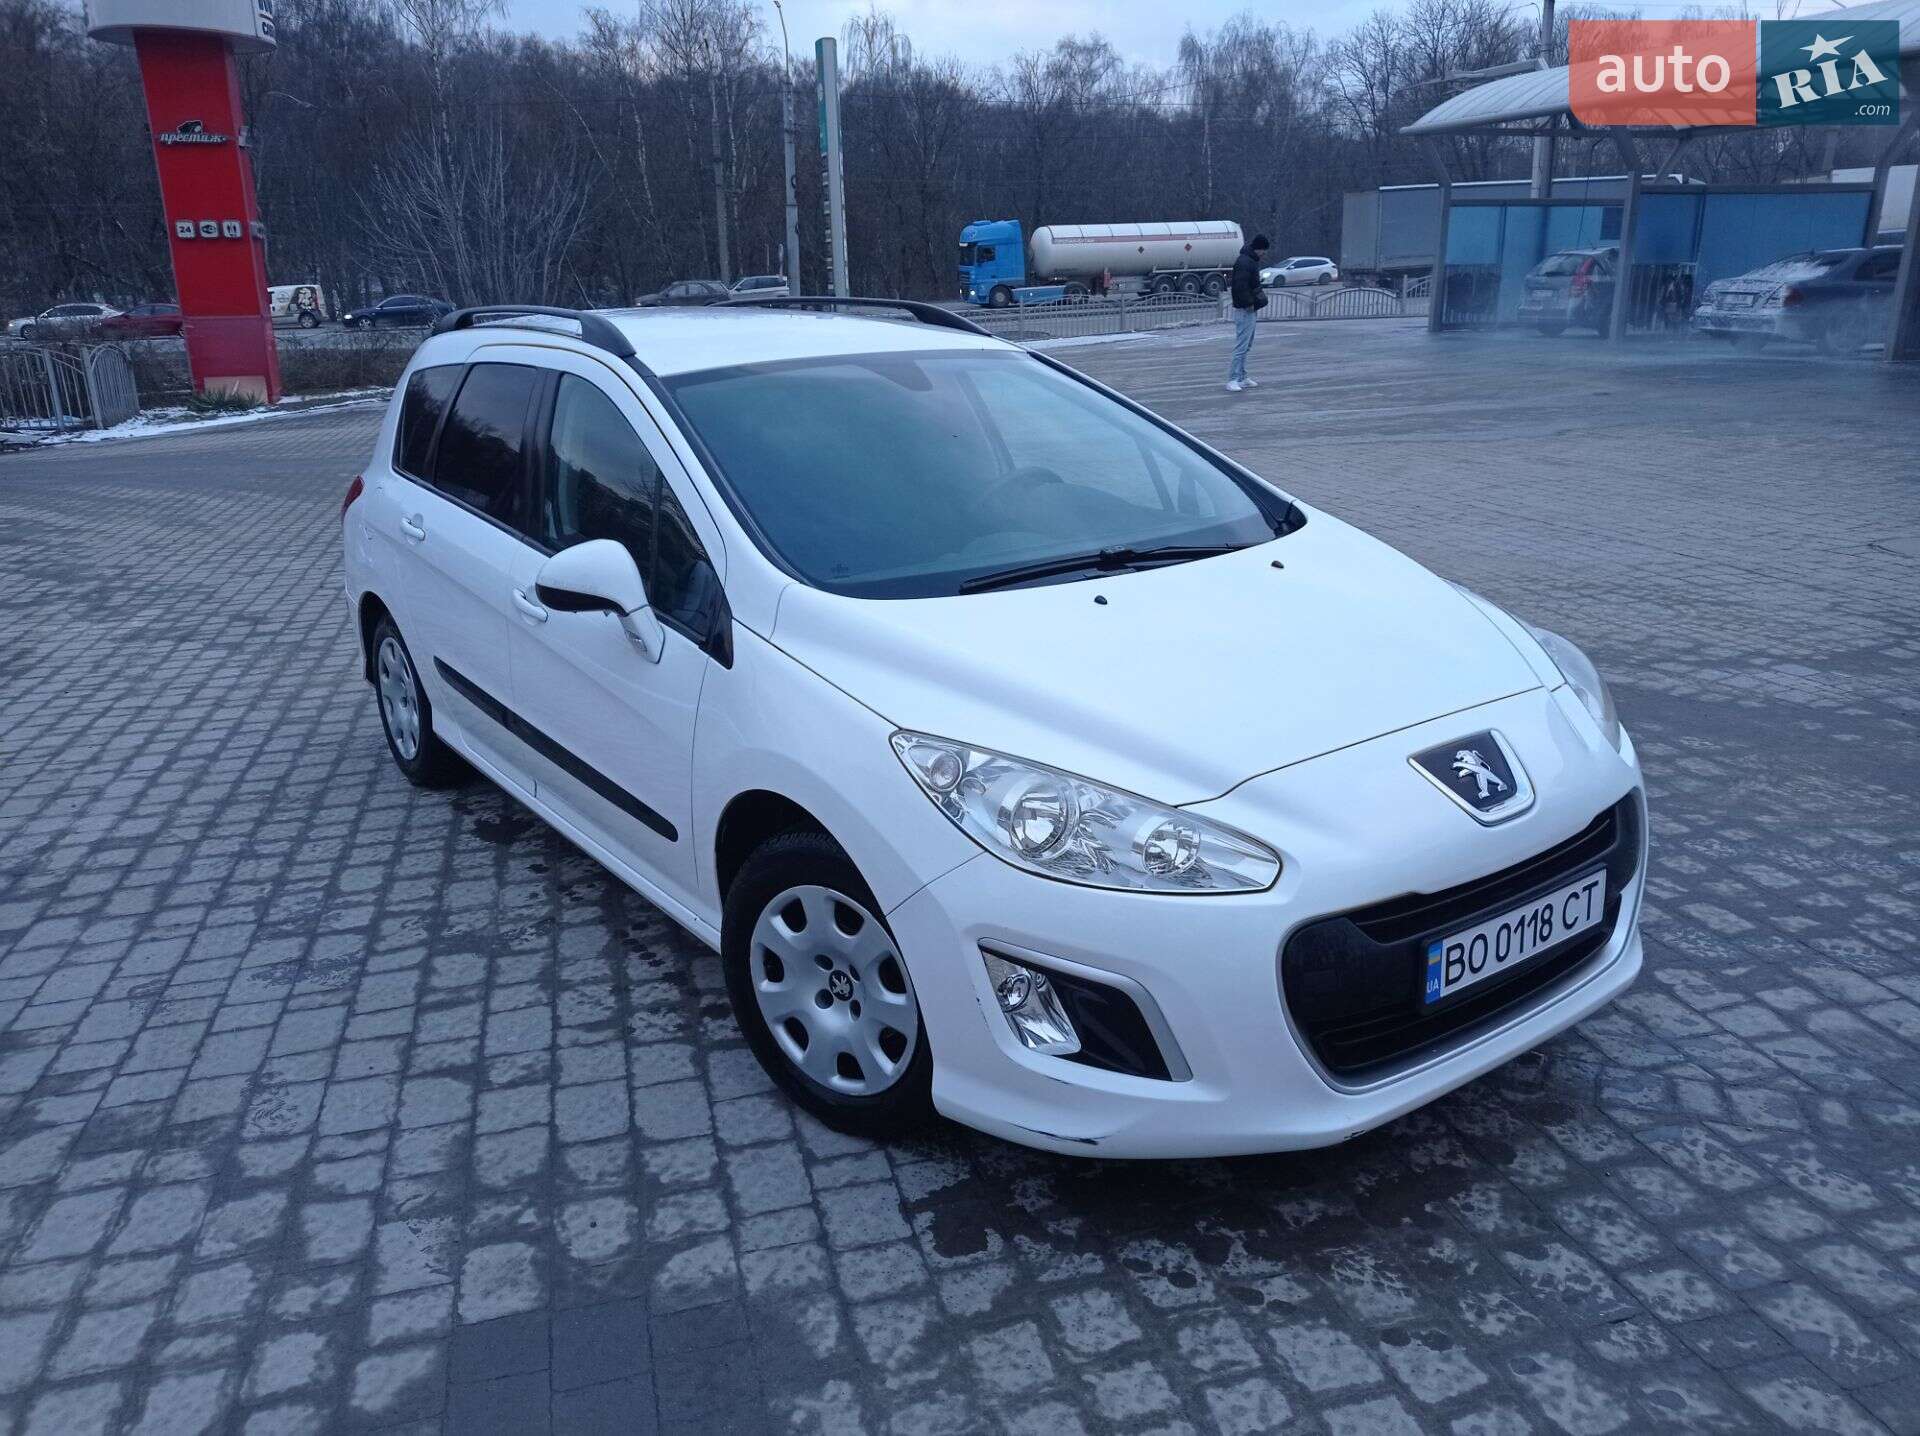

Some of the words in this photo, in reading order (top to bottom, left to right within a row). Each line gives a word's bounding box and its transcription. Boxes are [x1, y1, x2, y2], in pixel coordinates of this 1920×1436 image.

[178, 225, 192, 233] 24
[1445, 933, 1489, 987] BO
[1495, 903, 1554, 962] 0118
[1562, 880, 1599, 930] CT
[1426, 980, 1440, 994] UA
